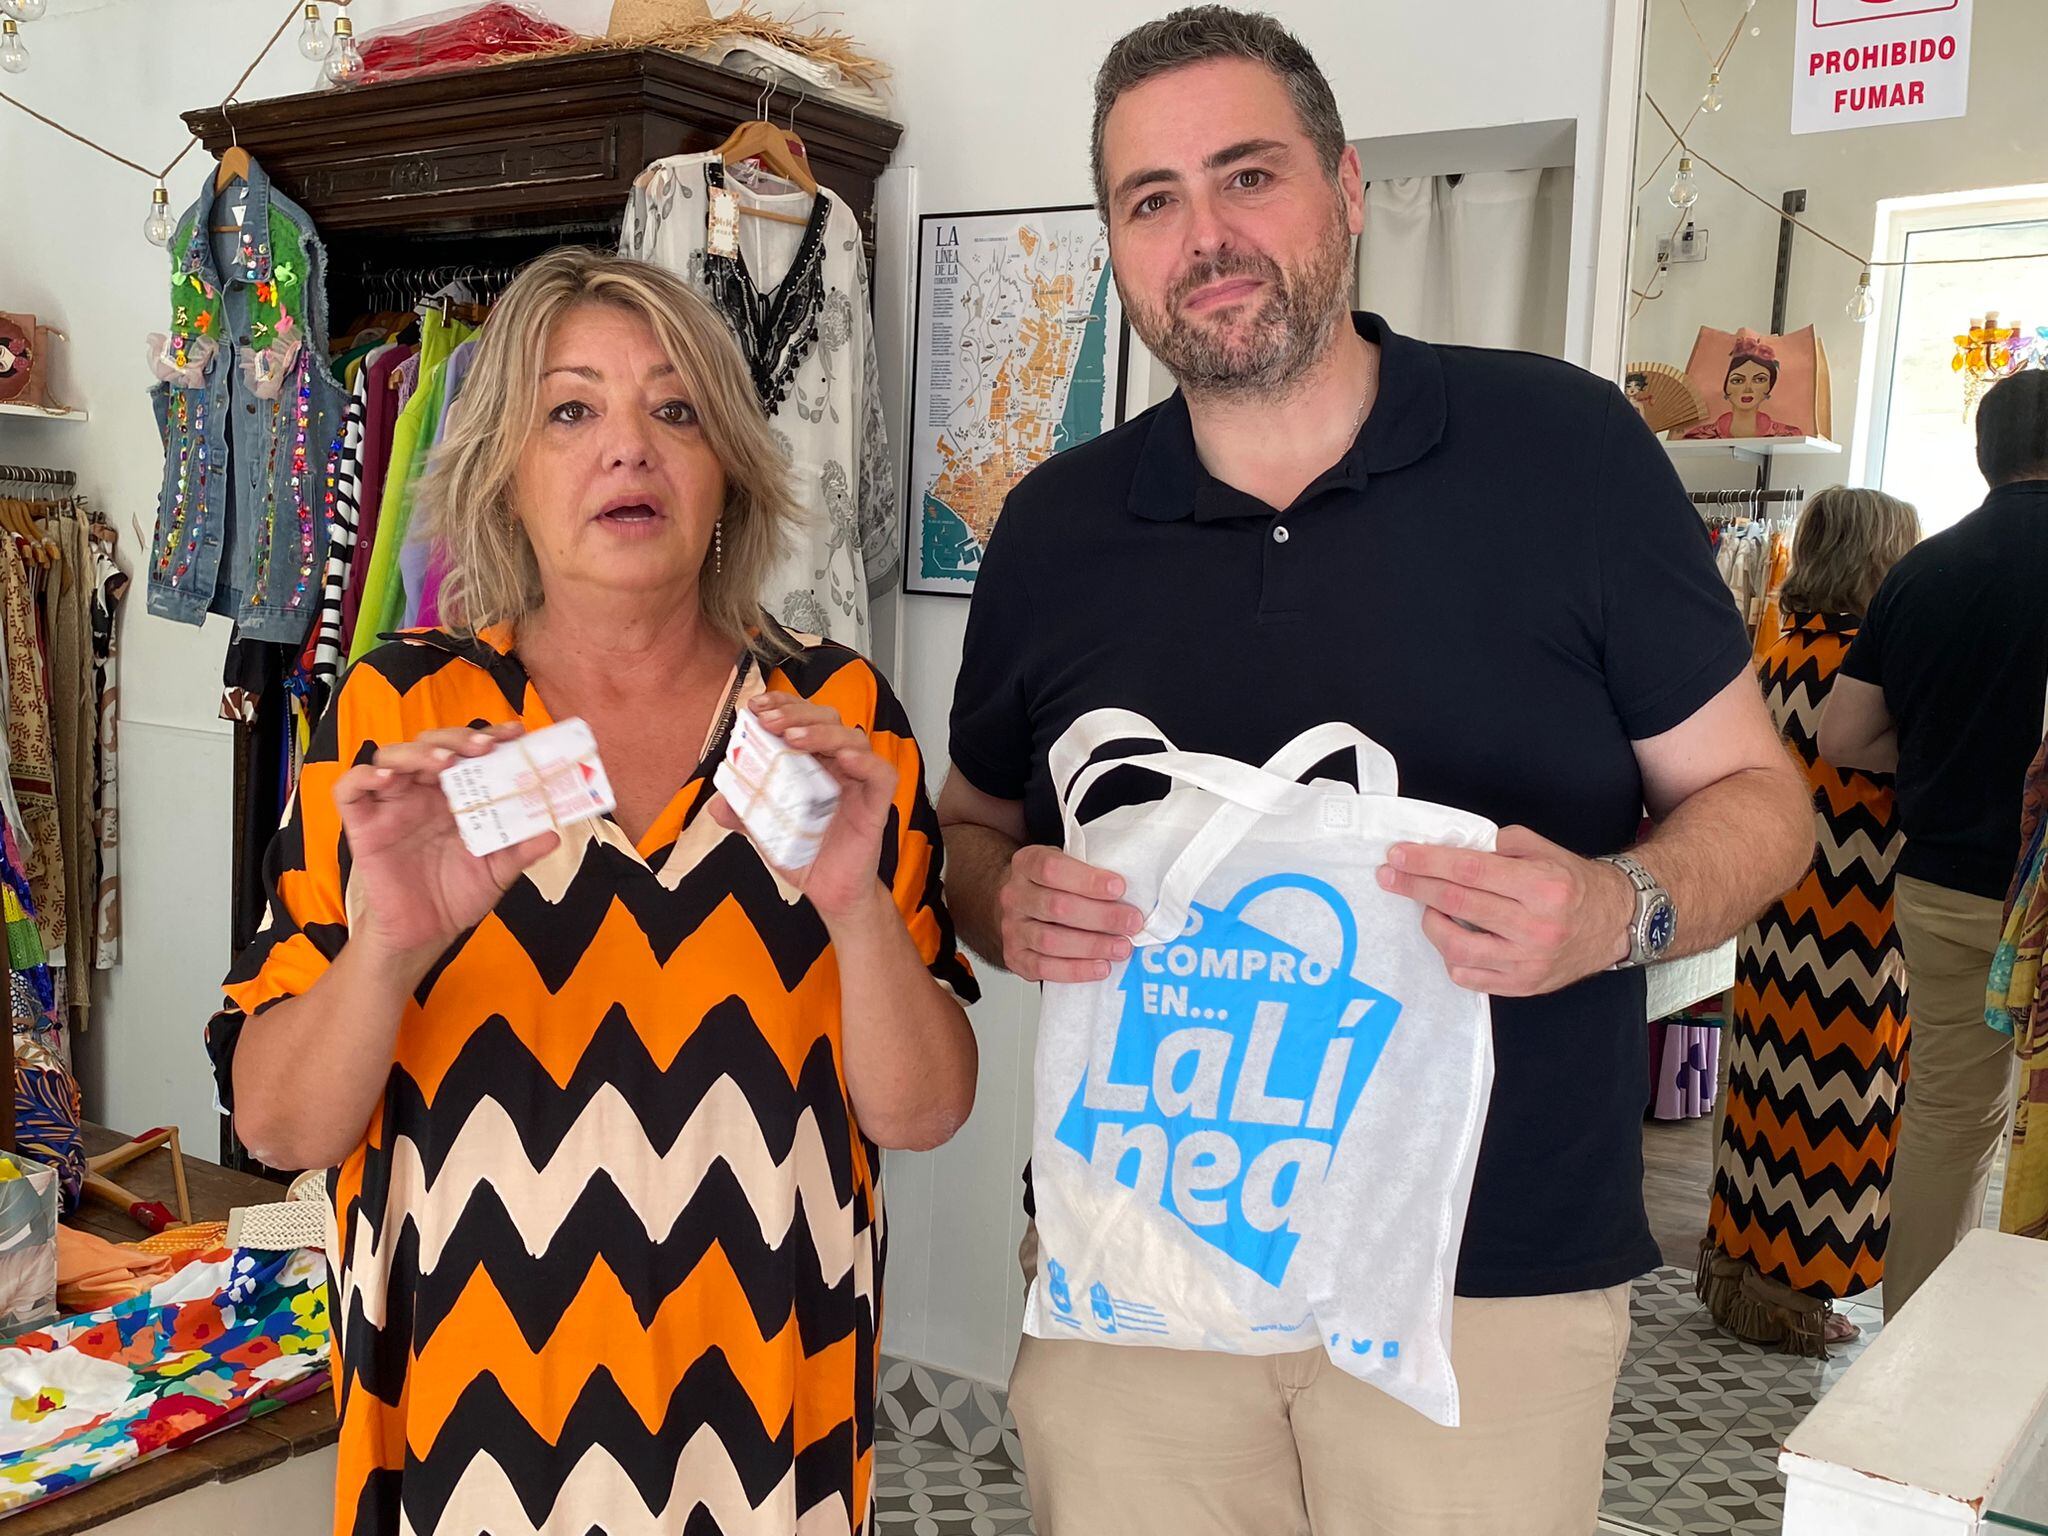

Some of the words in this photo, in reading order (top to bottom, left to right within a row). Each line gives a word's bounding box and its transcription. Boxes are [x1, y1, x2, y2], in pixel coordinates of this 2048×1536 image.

[1809, 35, 1956, 76] PROHIBIDO
[1834, 80, 1925, 113] FUMAR
[936, 225, 960, 247] LA
[935, 247, 960, 264] LÍNEA
[935, 264, 946, 276] DE
[947, 264, 959, 276] LA
[1141, 943, 1333, 987] COMPRO
[1142, 982, 1229, 1021] EN...
[1088, 1121, 1334, 1236] nea
